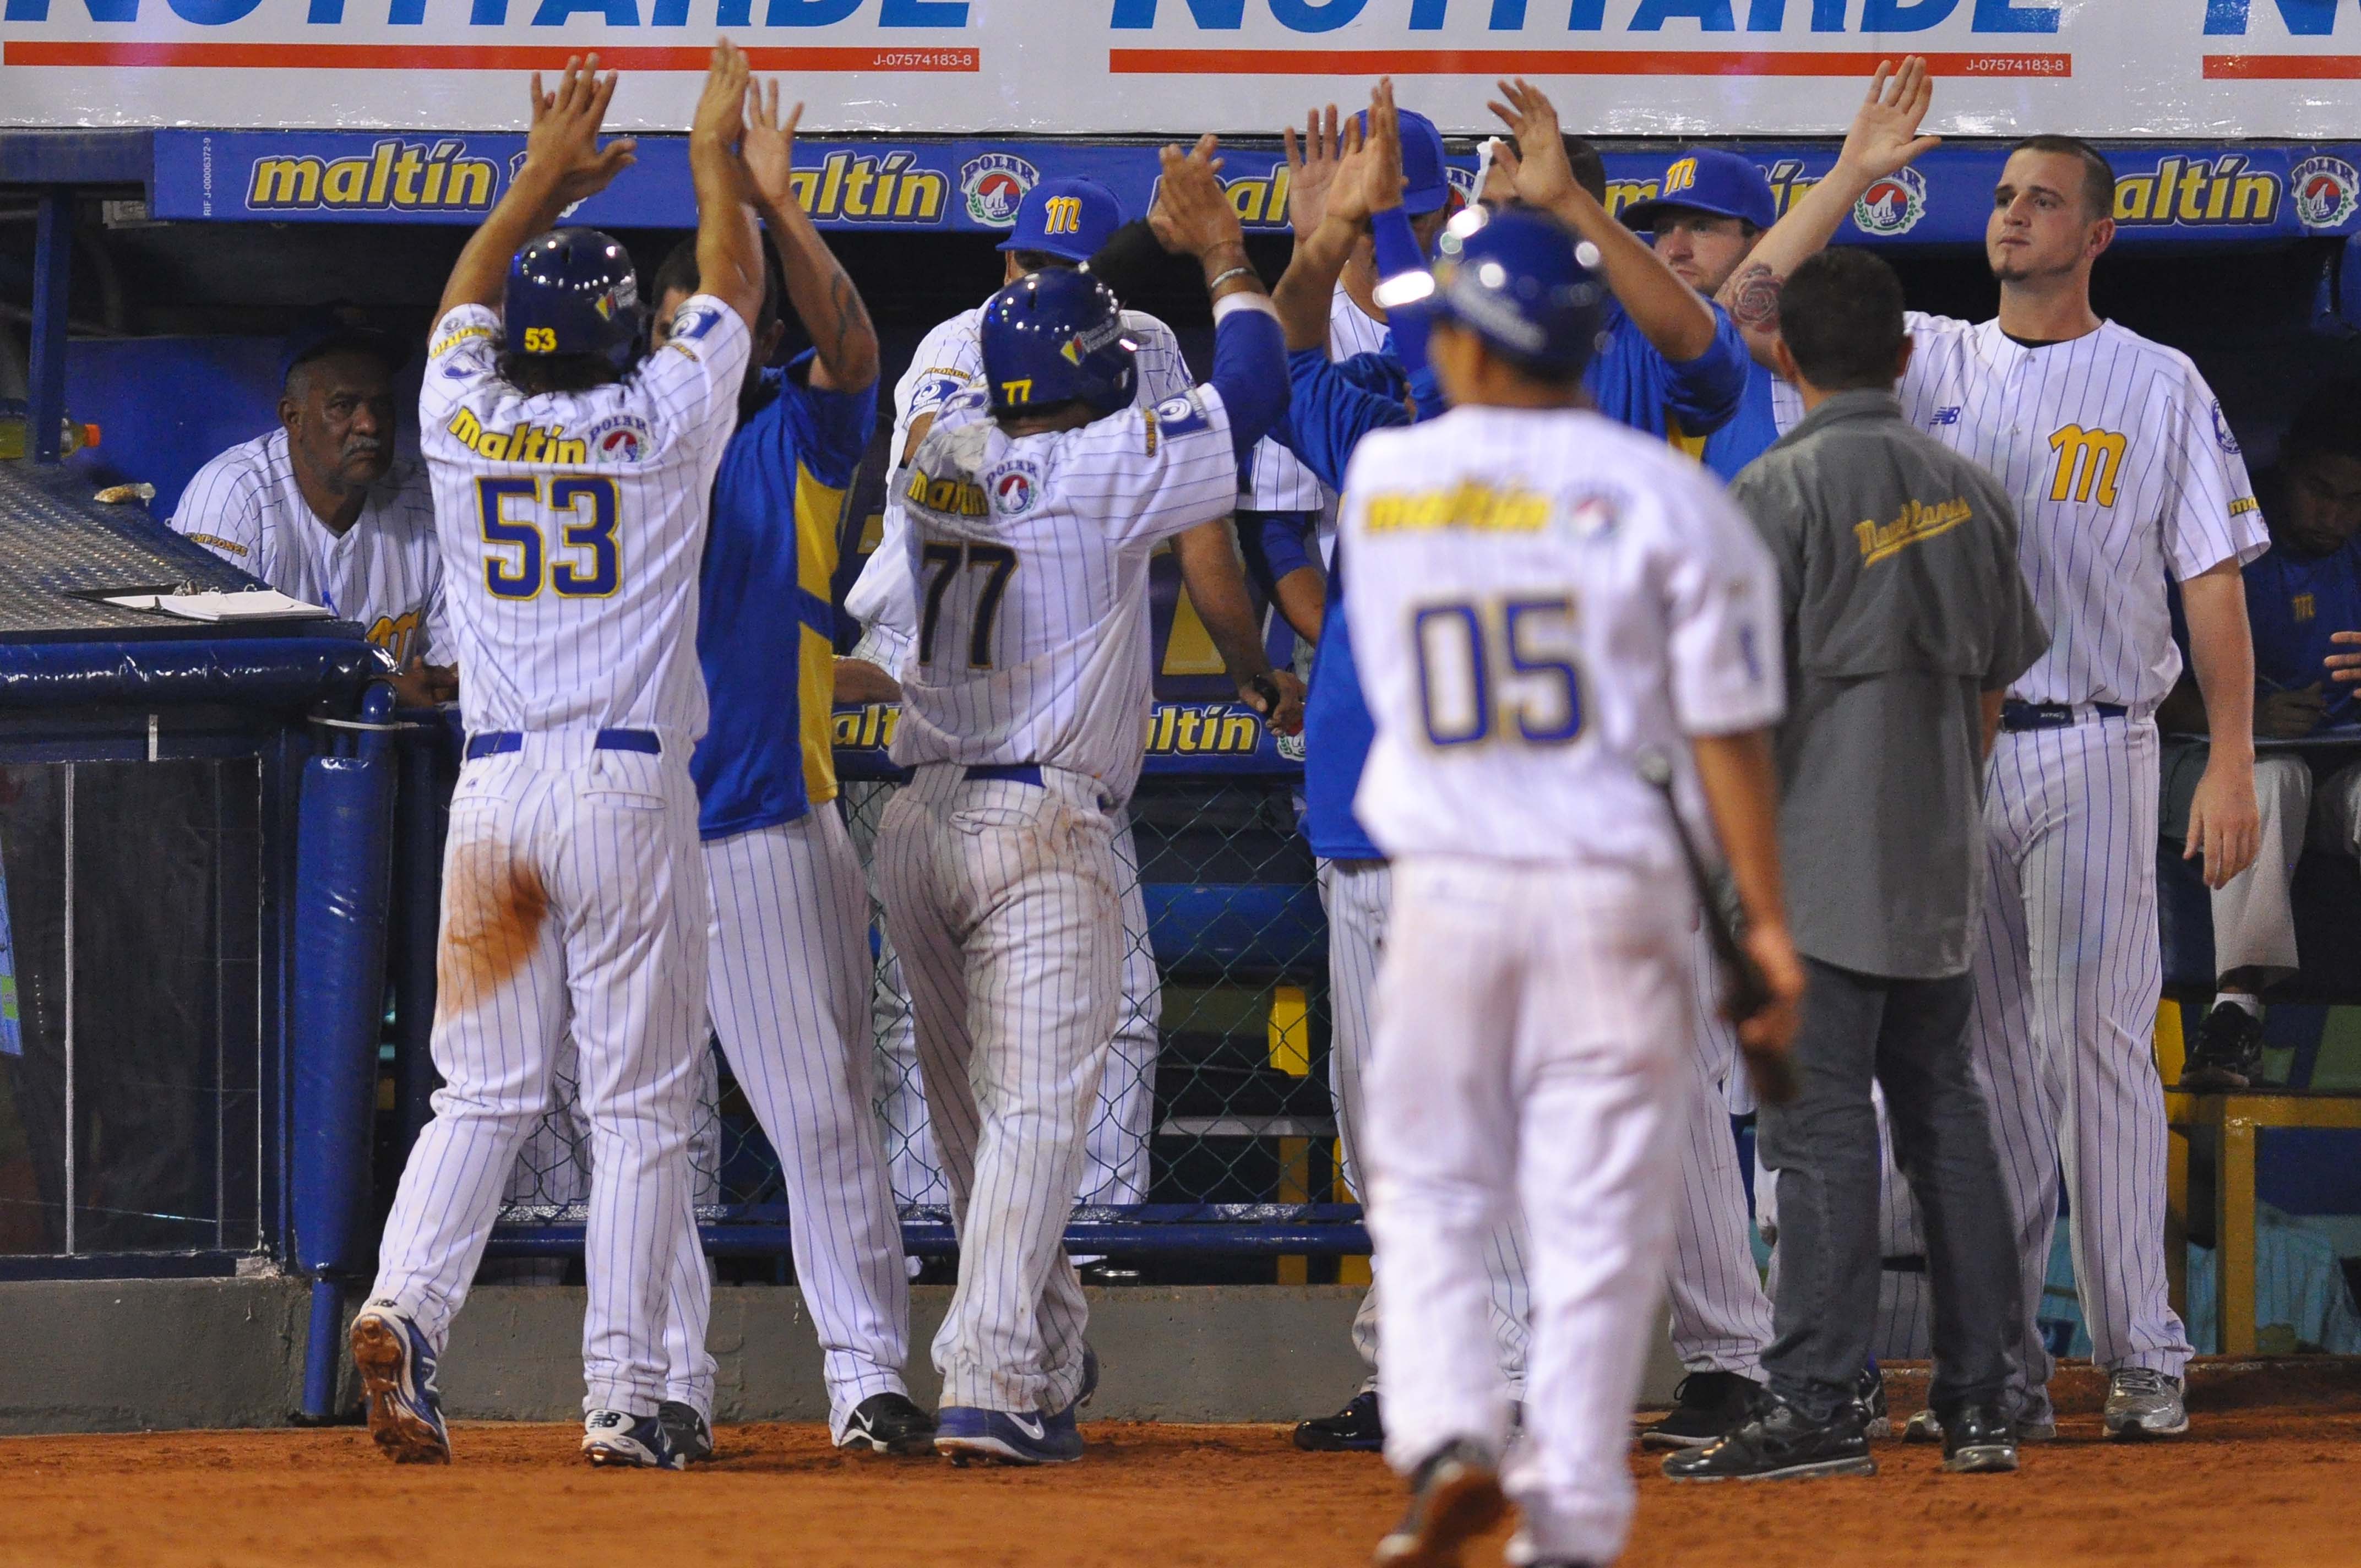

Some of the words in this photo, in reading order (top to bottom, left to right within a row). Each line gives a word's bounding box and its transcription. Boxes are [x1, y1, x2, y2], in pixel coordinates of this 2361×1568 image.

[873, 54, 972, 66] J-07574183-8
[1966, 59, 2064, 71] J-07574183-8
[249, 140, 497, 209] maltín
[790, 152, 947, 222] altín
[964, 155, 1040, 190] POLAR
[2113, 155, 2282, 225] altín
[203, 199, 211, 216] RIF
[525, 327, 557, 352] 53
[1002, 379, 1032, 405] 77
[447, 405, 586, 464] maltín
[589, 413, 649, 444] POLAR
[475, 473, 622, 601] 53
[918, 538, 1020, 669] 77
[1403, 589, 1594, 753] 05
